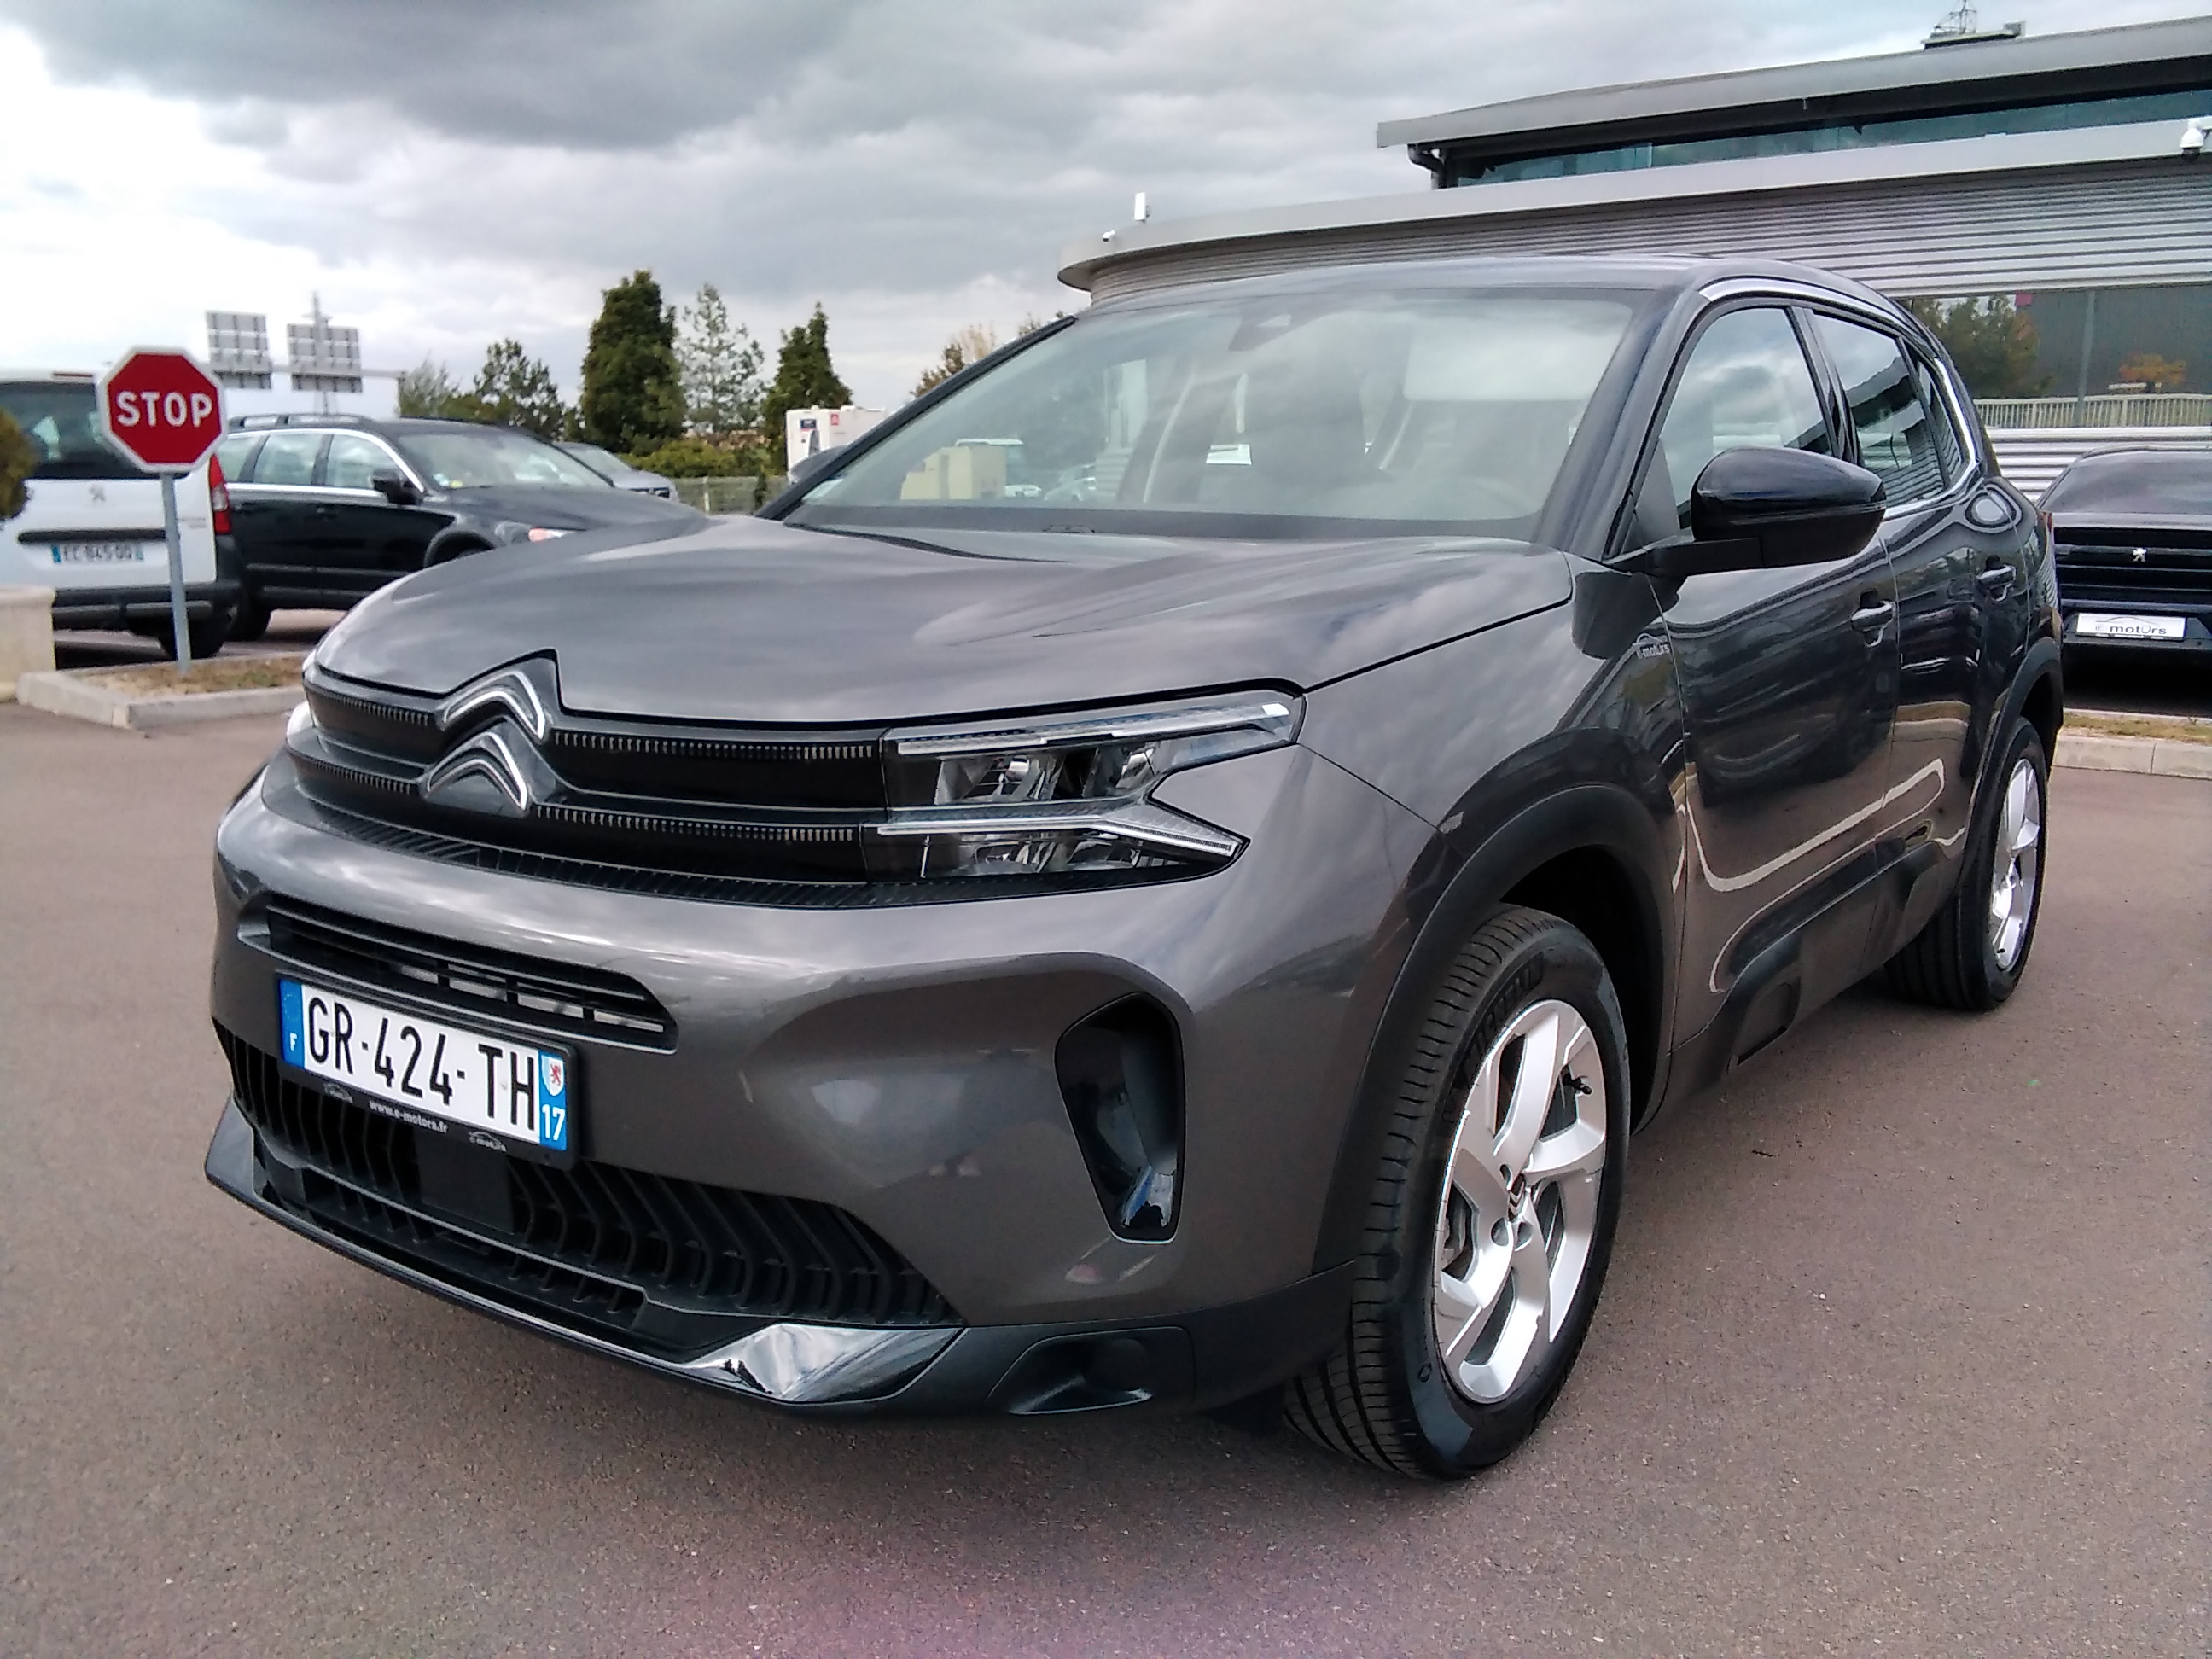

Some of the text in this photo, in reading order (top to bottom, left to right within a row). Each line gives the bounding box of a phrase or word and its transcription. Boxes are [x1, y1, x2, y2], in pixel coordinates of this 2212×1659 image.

[116, 390, 212, 427] STOP
[289, 1032, 298, 1051] F
[308, 997, 535, 1132] GR-424-TH
[369, 1100, 448, 1133] www.e-motors.fr
[542, 1103, 566, 1141] 17
